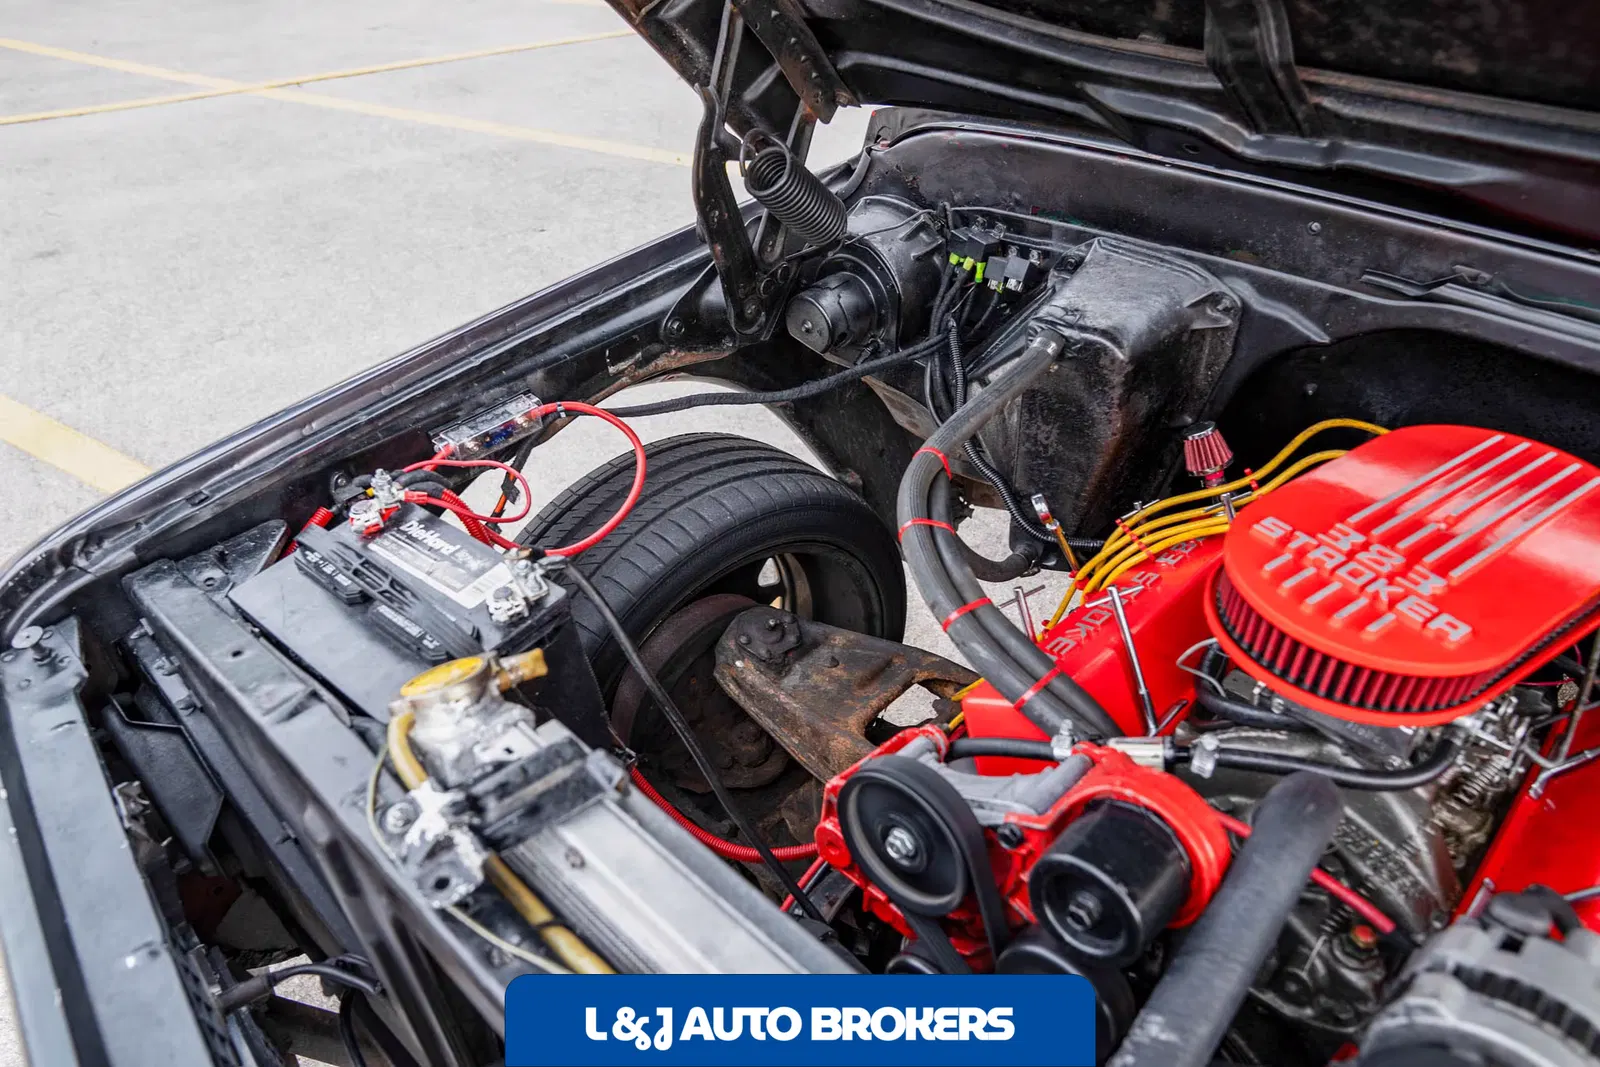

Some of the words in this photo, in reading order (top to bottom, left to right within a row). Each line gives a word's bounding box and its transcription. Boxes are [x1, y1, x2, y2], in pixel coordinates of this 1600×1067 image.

[399, 519, 461, 556] DieHard
[1155, 535, 1207, 565] 83
[1315, 522, 1448, 597] 383
[1251, 515, 1473, 642] STROKER
